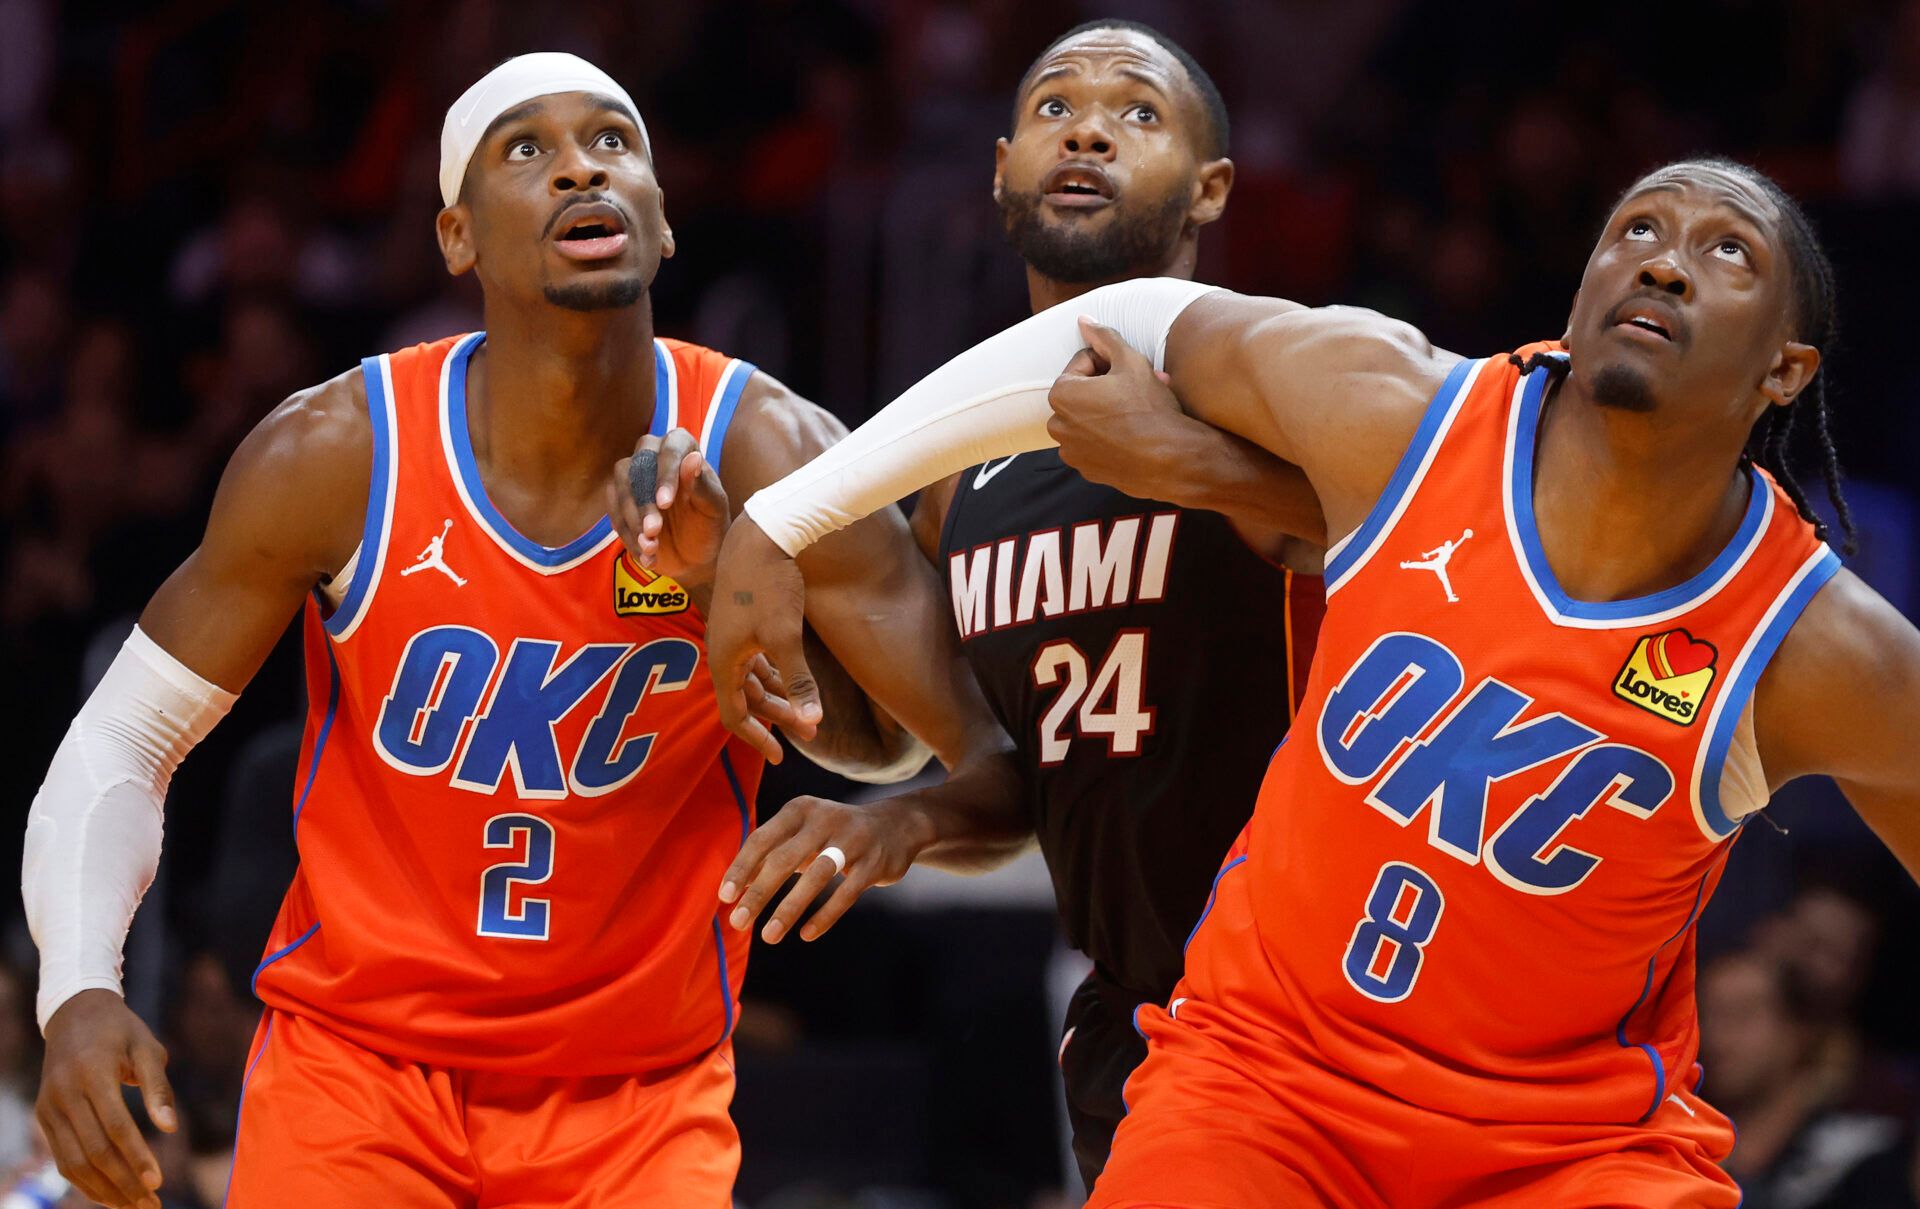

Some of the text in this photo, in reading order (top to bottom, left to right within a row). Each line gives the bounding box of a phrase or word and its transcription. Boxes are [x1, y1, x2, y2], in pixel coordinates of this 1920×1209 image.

[950, 510, 1181, 642] MIAMI
[372, 624, 699, 800] OKC
[1030, 627, 1157, 767] 24
[1317, 631, 1675, 895] OKC
[476, 812, 555, 941] 2
[1341, 860, 1445, 1003] 8
